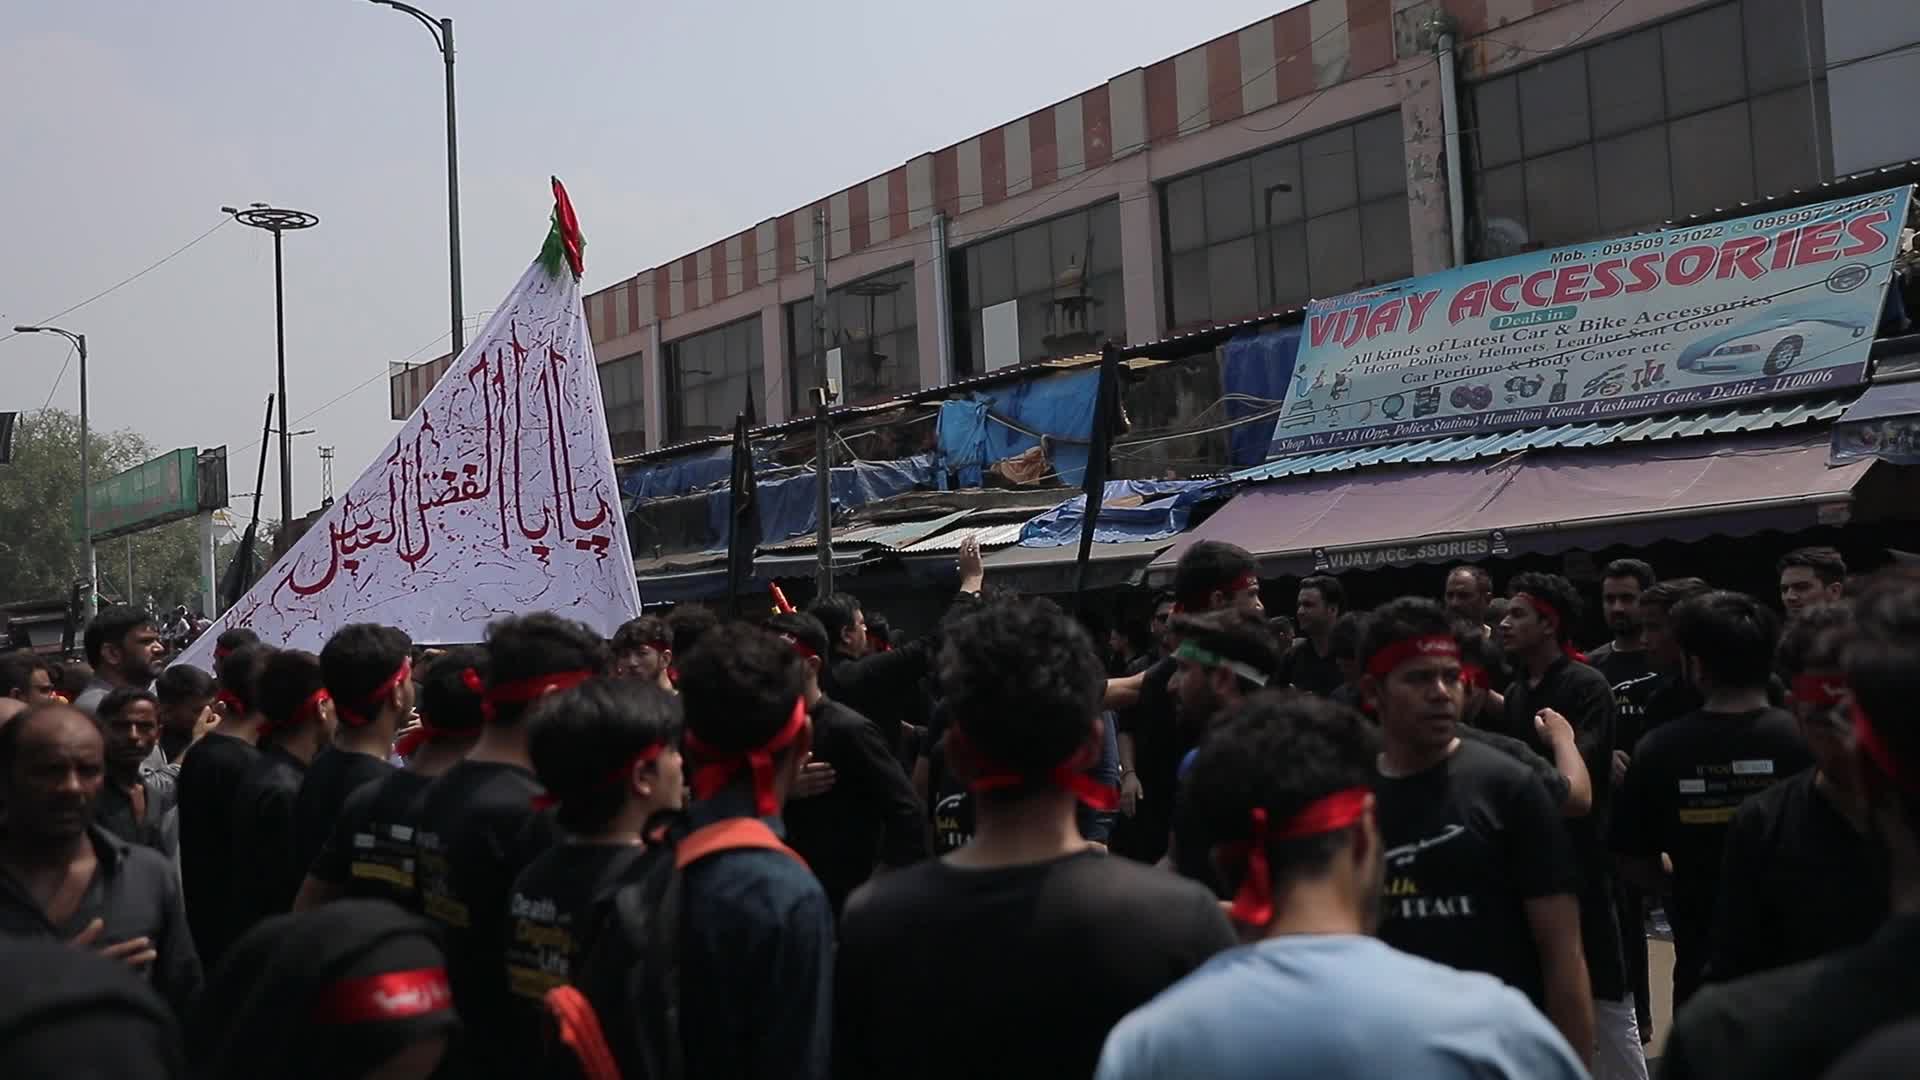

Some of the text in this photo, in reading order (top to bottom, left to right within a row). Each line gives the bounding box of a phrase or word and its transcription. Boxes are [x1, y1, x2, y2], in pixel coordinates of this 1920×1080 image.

[1551, 250, 1586, 265] Mob.
[1602, 236, 1664, 256] 093509
[1669, 226, 1724, 246] 21022
[1753, 207, 1825, 231] 098997
[1309, 210, 1891, 349] VIJAY ACCESSORIES
[1349, 295, 1773, 367] All kinds of Latest Car & Bike Accessories
[1498, 311, 1542, 328] Deals
[1556, 329, 1623, 349] Leather
[1674, 316, 1736, 333] Cover
[1401, 372, 1429, 385] Car
[1432, 362, 1502, 380] Perfume
[1527, 353, 1575, 369] Body
[1280, 438, 1305, 451] Shop
[1309, 434, 1324, 446] No.
[1328, 429, 1358, 444] 17-18
[1393, 420, 1430, 436] Police
[1430, 416, 1479, 432] Station)
[1483, 408, 1543, 425] Hamilton
[1590, 393, 1658, 414] Kashmiri
[1709, 380, 1756, 399] Delhi
[1771, 370, 1834, 392] 110006
[1328, 552, 1372, 568] VIJAY
